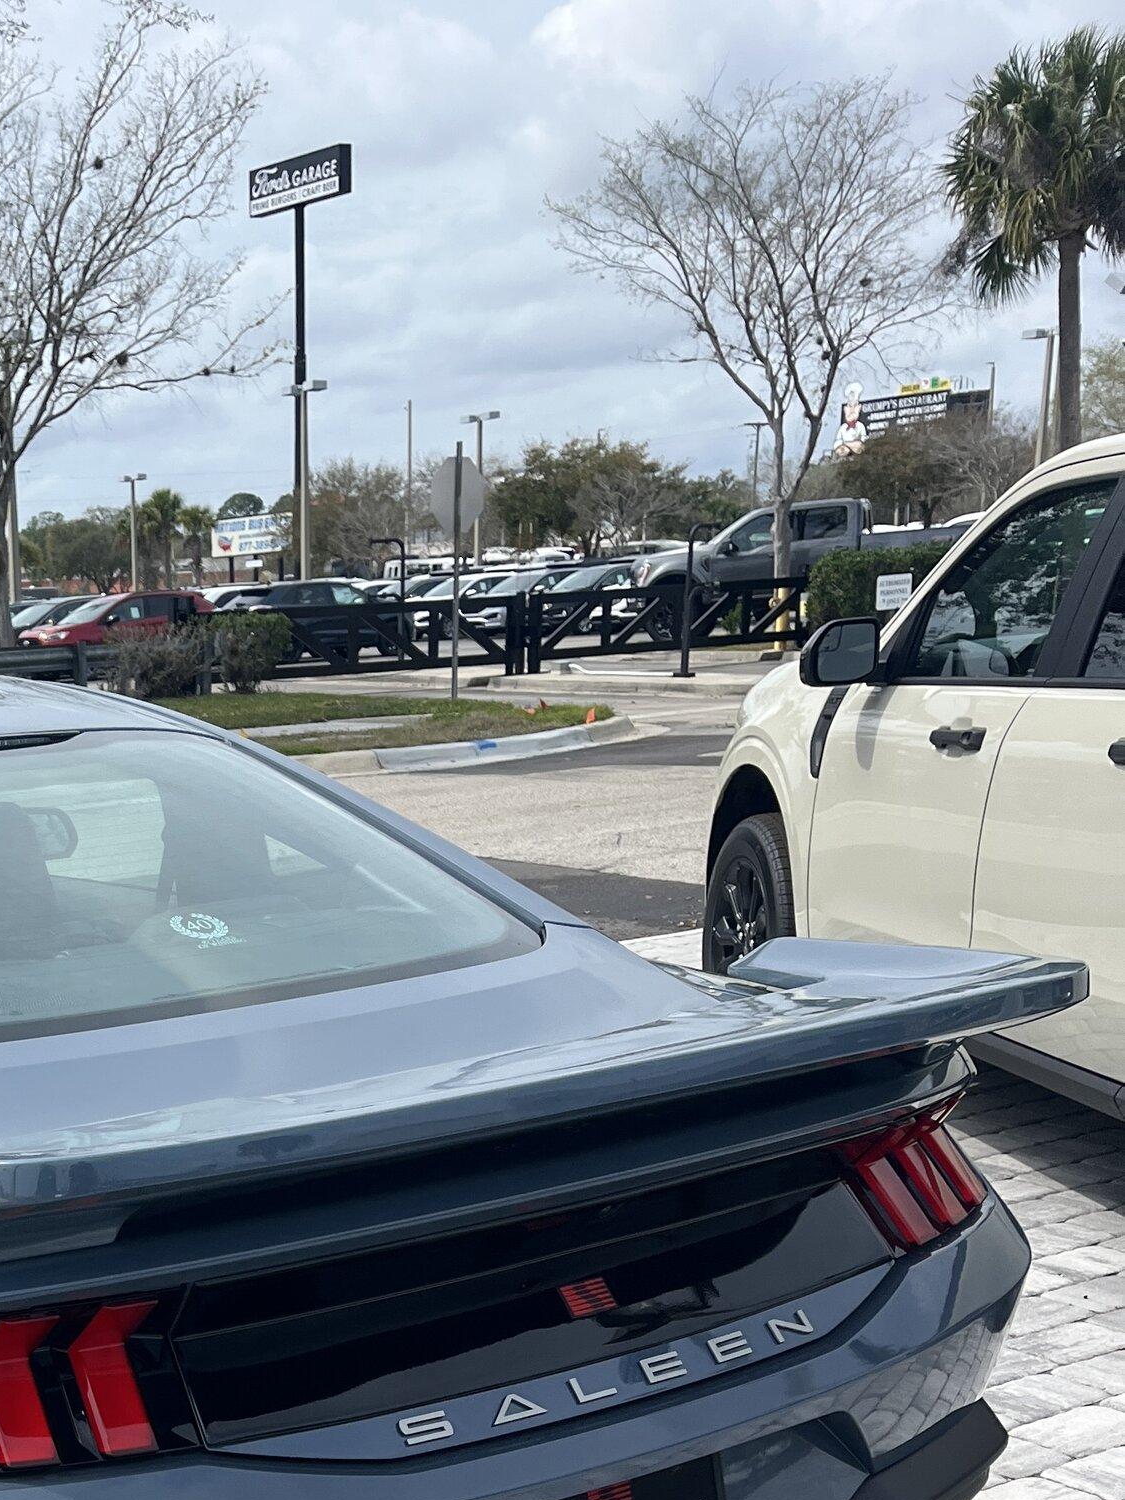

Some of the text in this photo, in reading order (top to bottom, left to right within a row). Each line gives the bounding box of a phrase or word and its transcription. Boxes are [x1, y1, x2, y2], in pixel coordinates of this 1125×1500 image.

[292, 159, 338, 187] GARAGE
[898, 392, 947, 407] RESTAURANT
[398, 1308, 814, 1446] SALEEN
